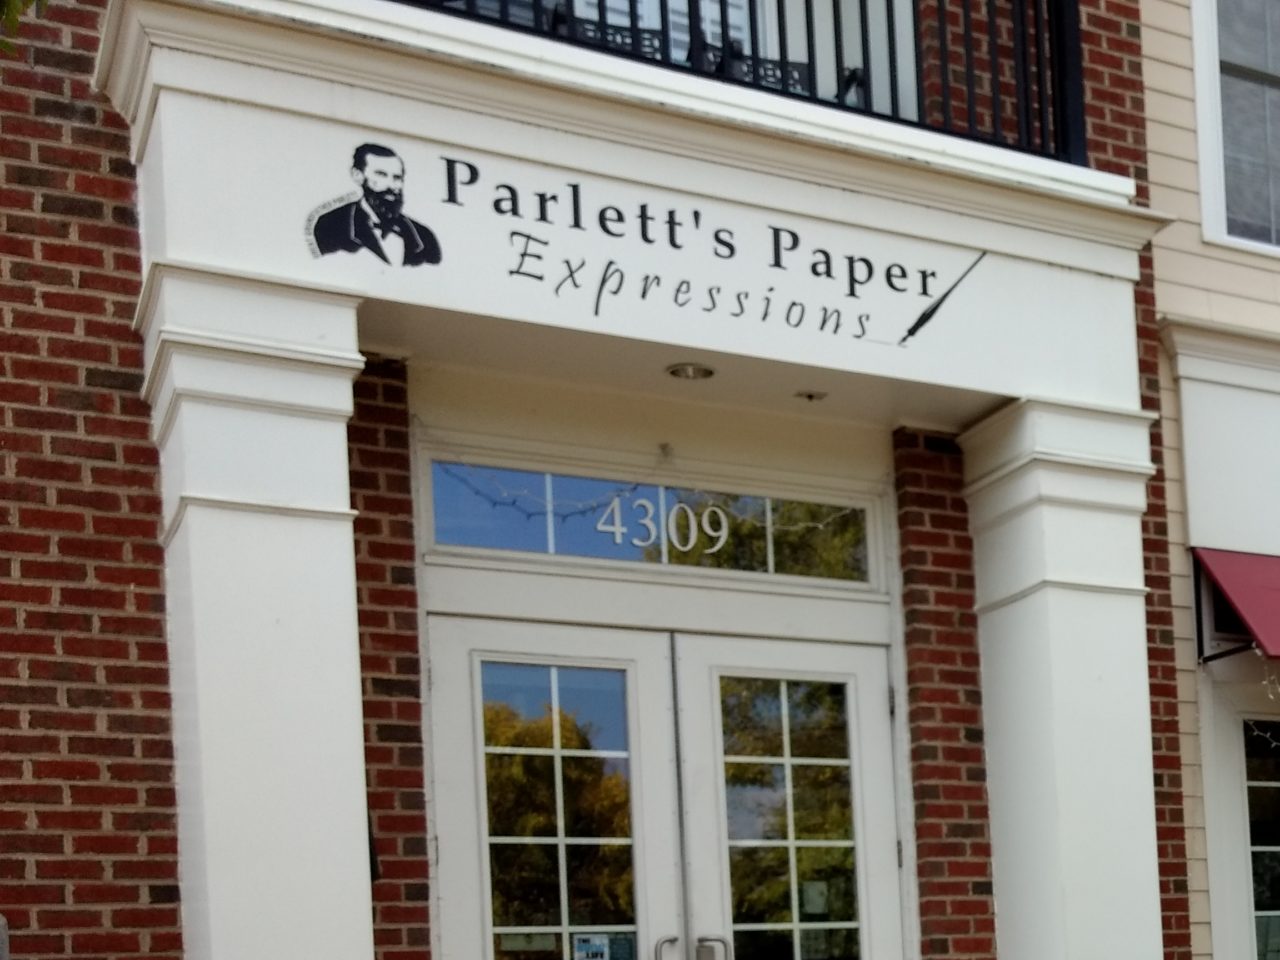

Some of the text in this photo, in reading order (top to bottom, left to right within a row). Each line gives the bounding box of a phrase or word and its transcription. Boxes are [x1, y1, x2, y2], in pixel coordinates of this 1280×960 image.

[439, 156, 737, 260] Parlett's
[766, 225, 938, 299] Paper
[508, 231, 871, 339] Expressions
[596, 496, 730, 555] 4309
